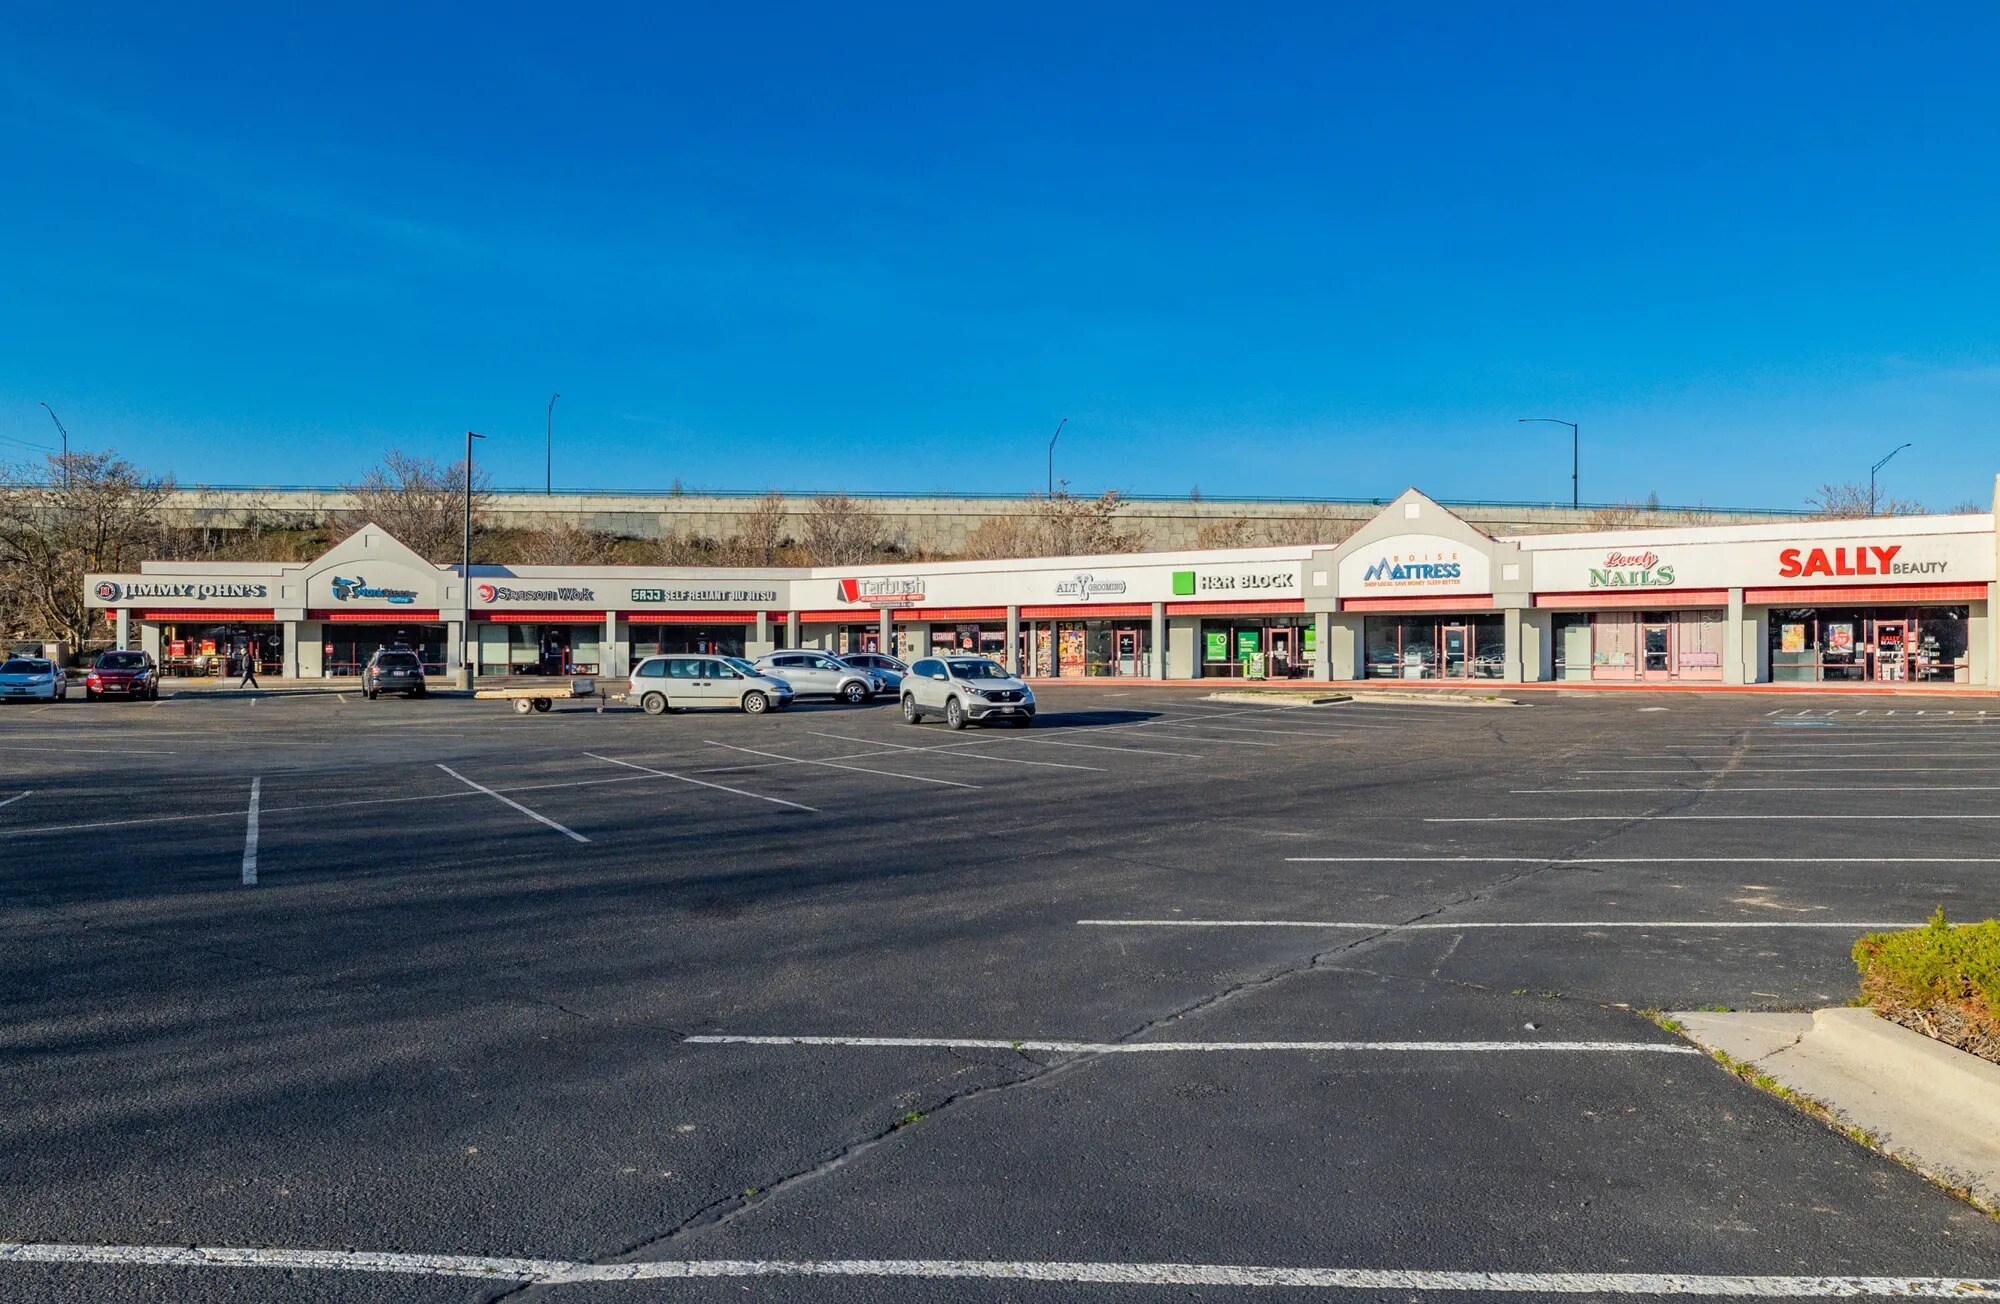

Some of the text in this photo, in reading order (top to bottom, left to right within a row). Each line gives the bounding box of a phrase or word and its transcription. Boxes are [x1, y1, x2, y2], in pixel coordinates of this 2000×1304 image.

[1393, 553, 1458, 562] BOISE
[1603, 551, 1658, 569] Lovely
[1778, 545, 1948, 578] SALLY BEAUTY
[1363, 557, 1461, 581] MATTRESS
[1589, 565, 1675, 587] NAILS
[860, 576, 926, 594] Tarbush
[1056, 583, 1124, 593] ALT GROOMING
[1200, 573, 1294, 589] H&R BLOCK
[120, 583, 188, 598] JIMMY
[190, 583, 262, 599] JOHN'S
[498, 587, 591, 600] Season Wok
[632, 590, 661, 600] SRJJ
[688, 590, 727, 601] RELIANT
[729, 591, 744, 600] JIU
[746, 591, 773, 600] JITSU
